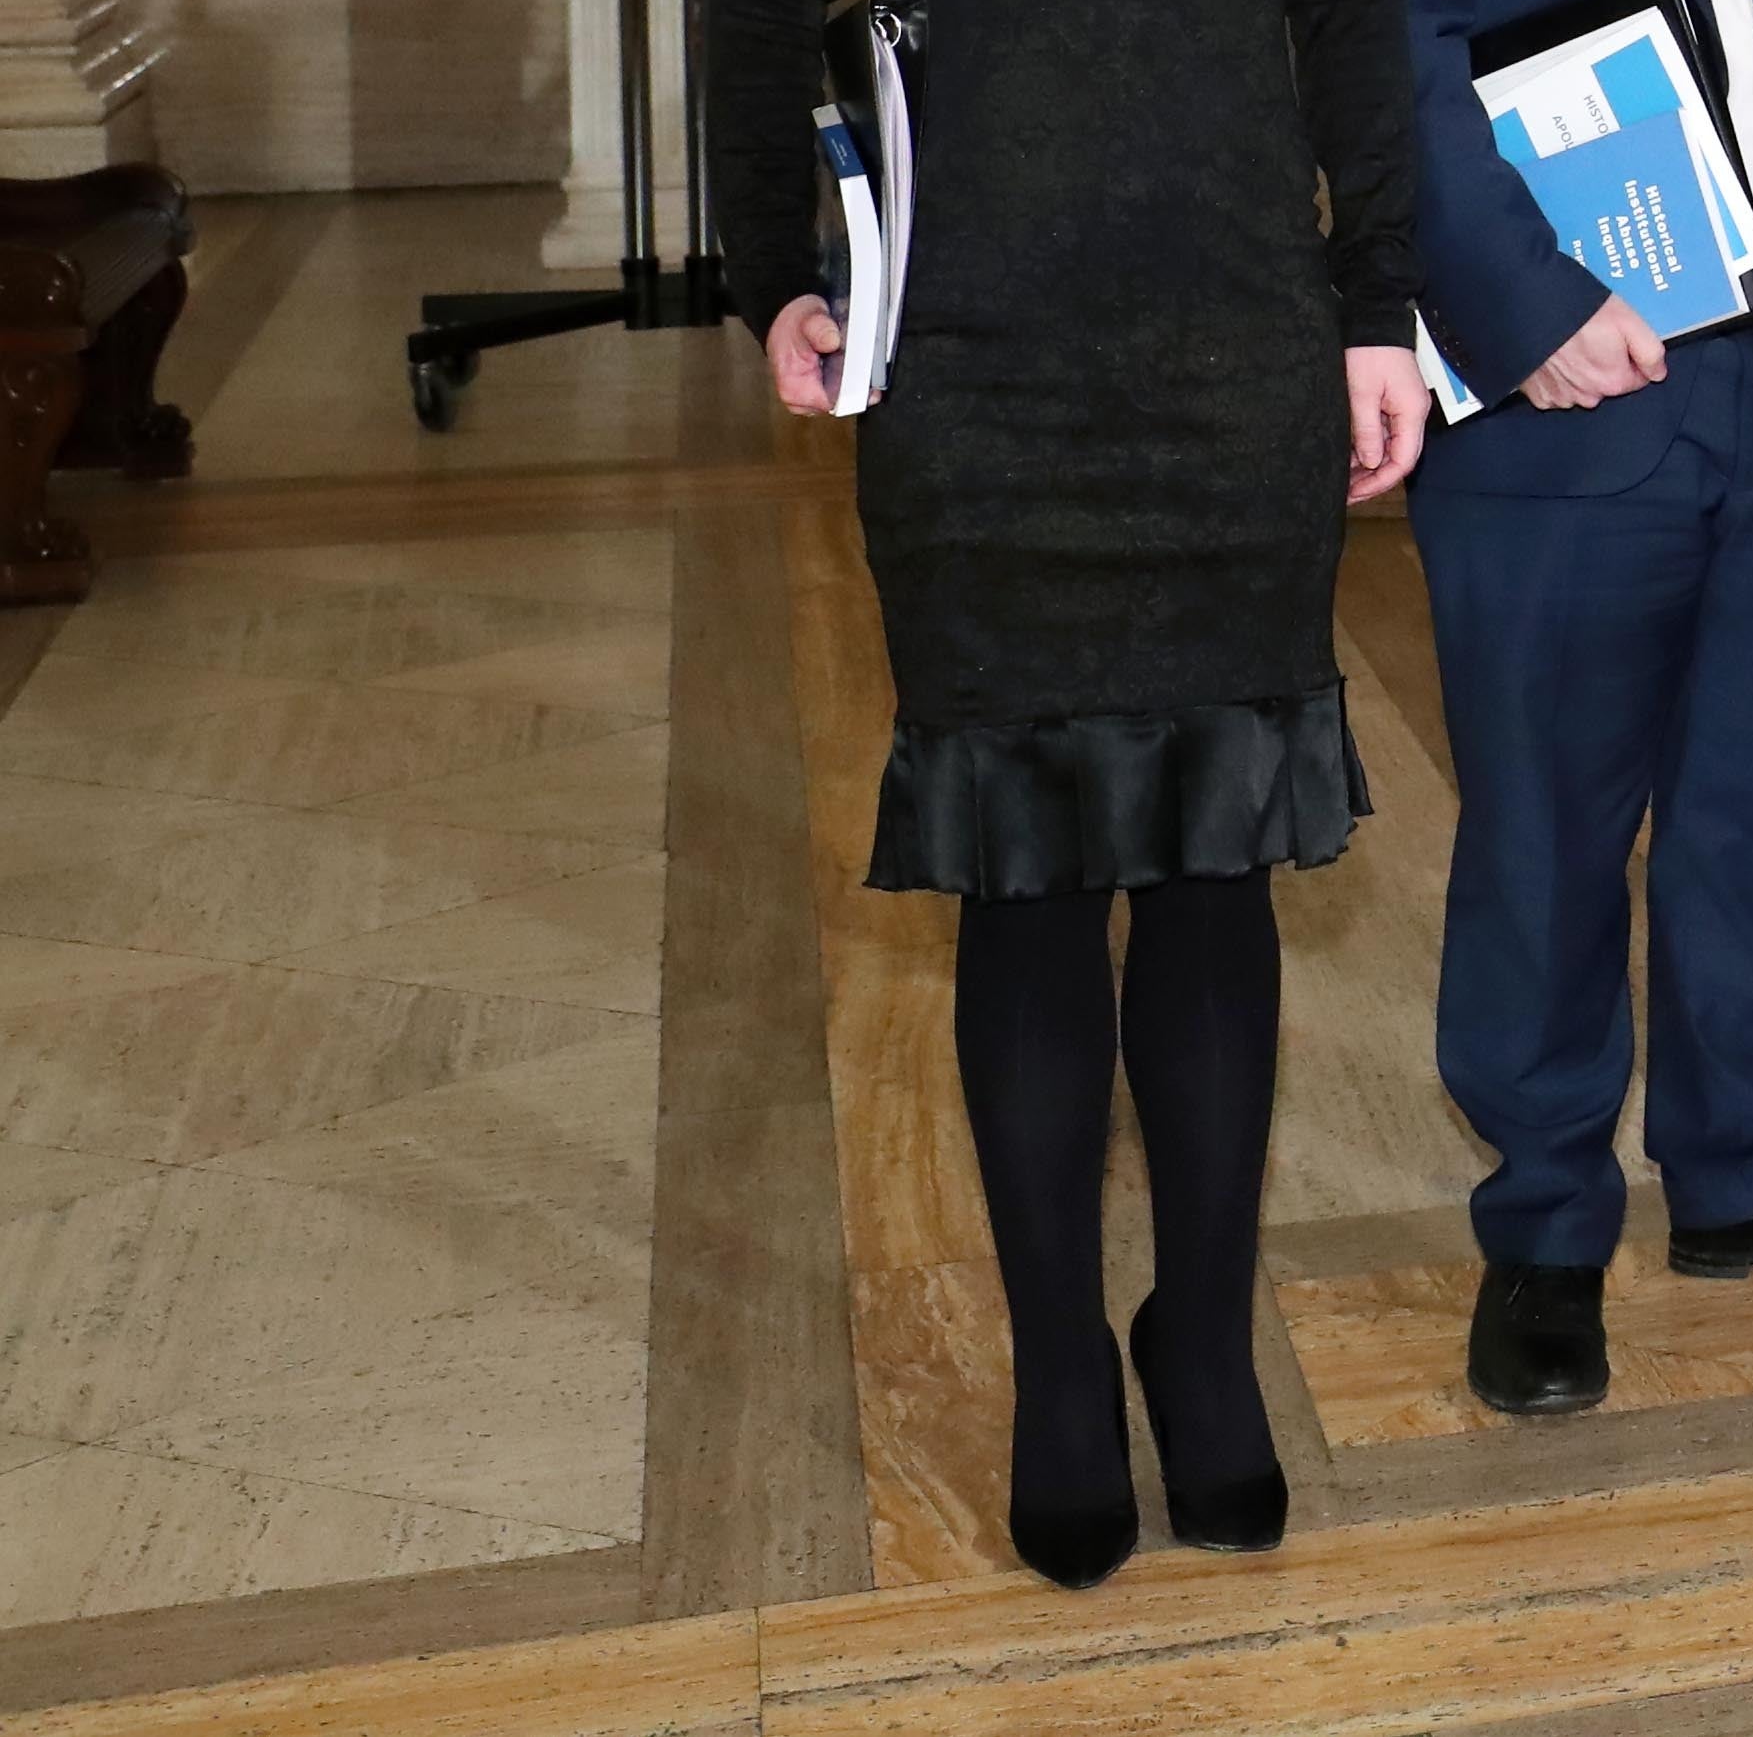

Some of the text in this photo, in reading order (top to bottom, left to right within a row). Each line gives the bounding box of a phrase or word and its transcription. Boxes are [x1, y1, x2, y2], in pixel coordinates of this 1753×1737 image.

[1552, 115, 1576, 150] APOL
[1583, 94, 1609, 135] HISTO
[1597, 216, 1625, 279] Inquiry
[1615, 215, 1640, 270] Abuse
[1624, 179, 1669, 292] Institutional
[1645, 184, 1682, 274] Historical
